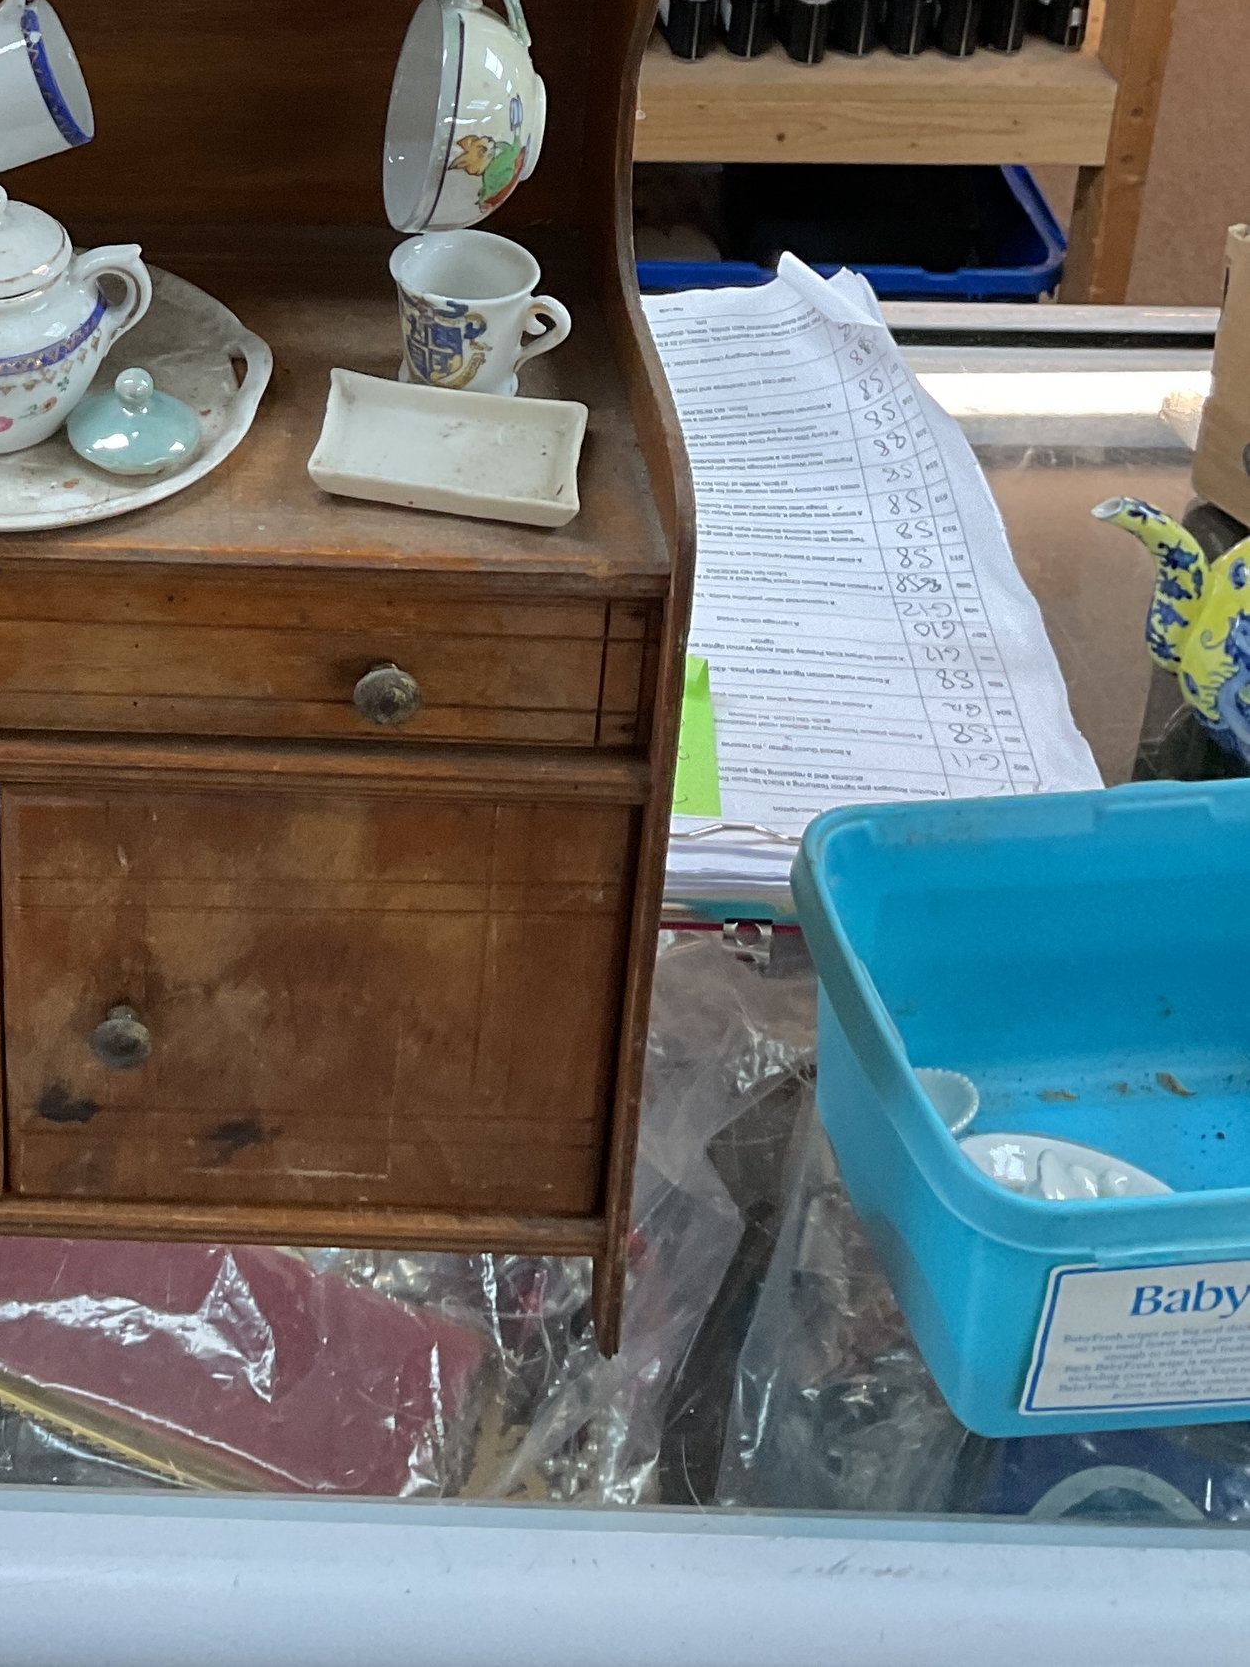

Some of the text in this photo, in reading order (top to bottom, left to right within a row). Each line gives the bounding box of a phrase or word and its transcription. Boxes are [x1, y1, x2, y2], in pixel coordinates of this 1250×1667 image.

[888, 489, 922, 515] S8
[896, 520, 933, 540] S8
[896, 547, 933, 569] S8
[935, 668, 974, 689] S8
[948, 723, 993, 744] S8
[1129, 1279, 1250, 1319] Baby
